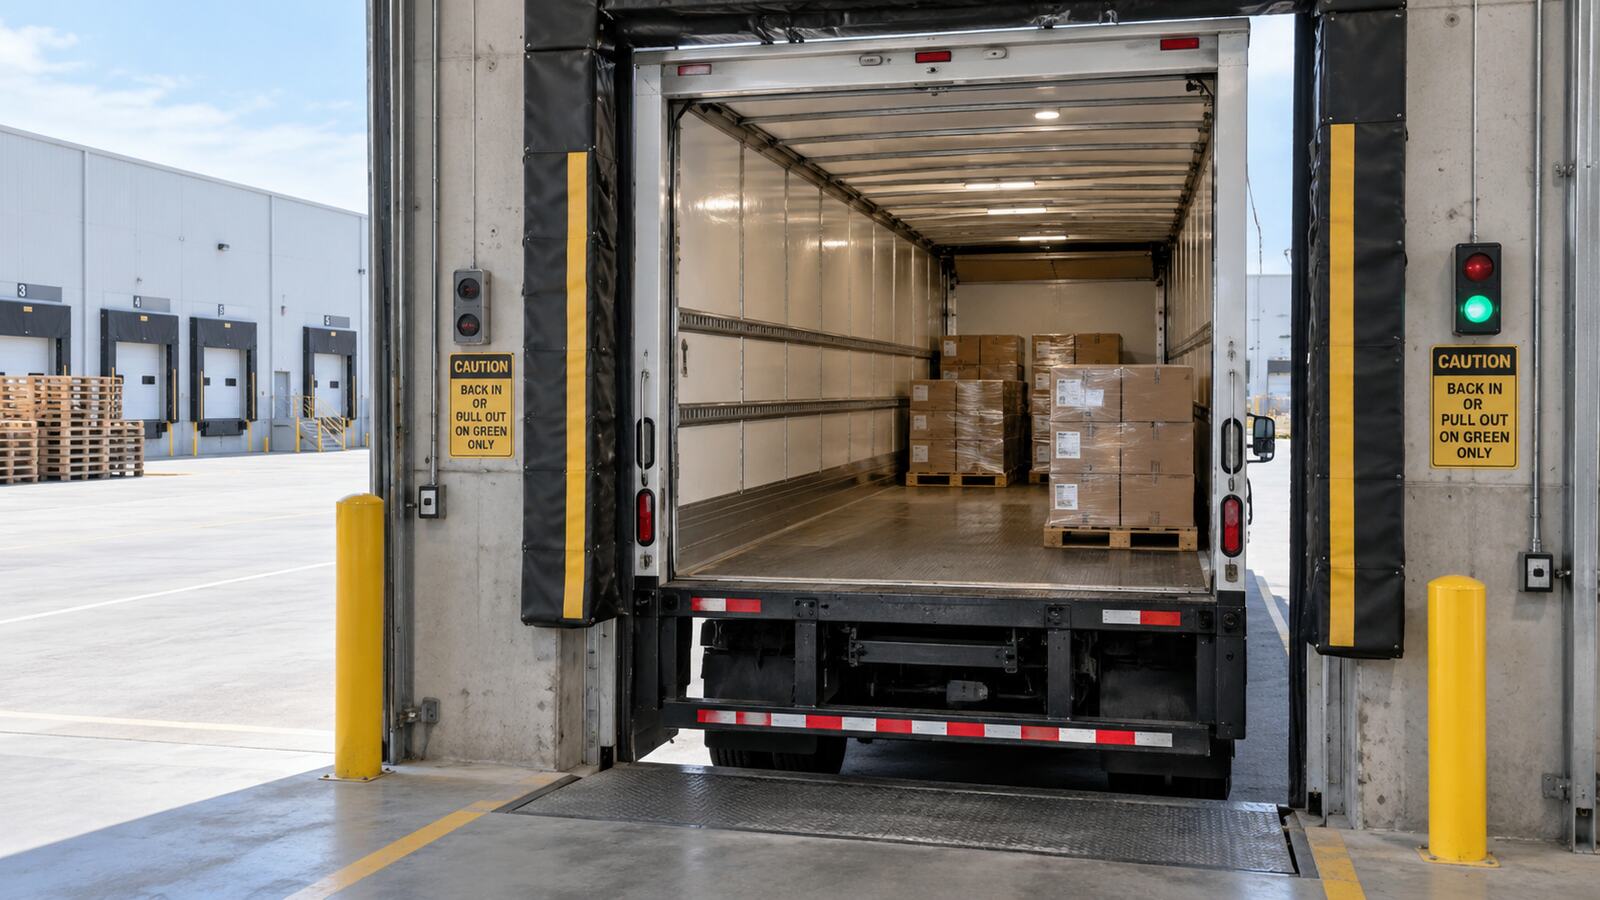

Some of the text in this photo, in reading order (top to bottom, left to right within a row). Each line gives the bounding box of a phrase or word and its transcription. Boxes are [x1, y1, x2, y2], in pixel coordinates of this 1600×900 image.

[19, 284, 26, 297] 3
[454, 360, 508, 373] CAUTION
[1438, 354, 1511, 369] CAUTION
[461, 385, 502, 395] BACK IN
[1447, 382, 1503, 395] BACK IN
[472, 399, 487, 408] OR
[1463, 398, 1483, 410] OR
[485, 411, 506, 422] OUT
[1441, 413, 1509, 426] PULL OUT
[455, 426, 507, 437] ON GREEN
[1439, 431, 1510, 443] ON GREEN
[468, 439, 495, 449] ONLY
[1457, 447, 1493, 459] ONLY
